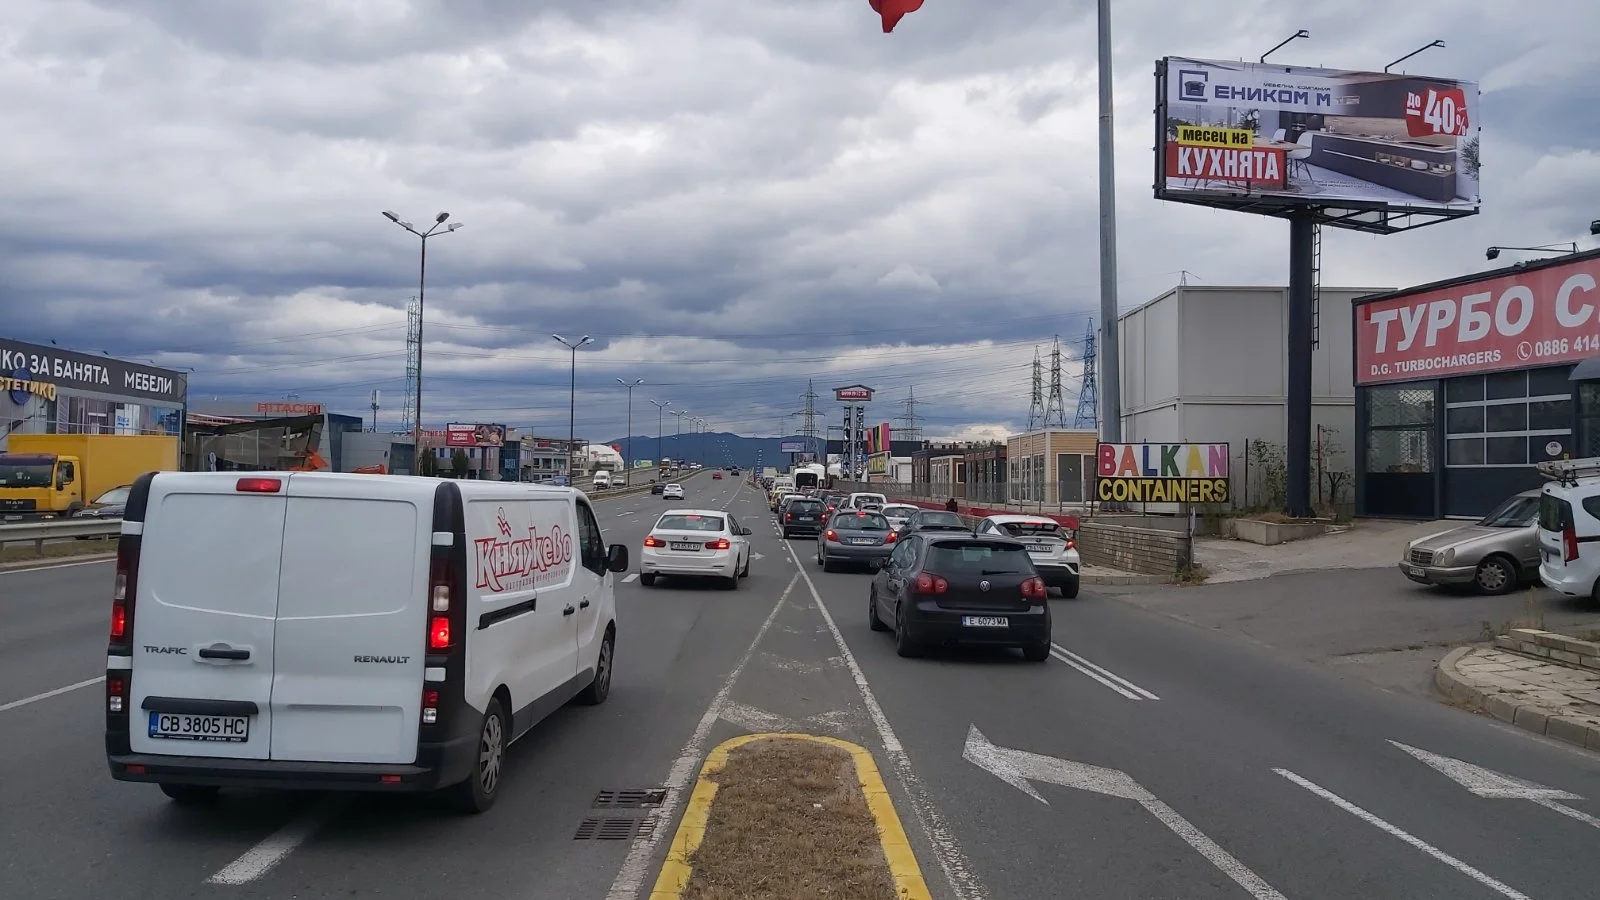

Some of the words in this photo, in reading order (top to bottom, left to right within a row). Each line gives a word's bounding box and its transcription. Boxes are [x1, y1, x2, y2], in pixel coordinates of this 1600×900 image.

[1214, 85, 1309, 105] ЕНИКОМ
[1316, 92, 1331, 106] М
[1183, 129, 1227, 144] месец
[1232, 132, 1248, 144] на
[1178, 147, 1280, 180] КУХНЯТА
[1370, 285, 1535, 354] ТУРБО
[1555, 273, 1600, 328] С
[1535, 338, 1569, 357] 0886
[1573, 334, 1600, 352] 414
[0, 349, 26, 370] КО
[30, 354, 50, 375] ЗА
[53, 358, 110, 386] БАНЯТА
[124, 371, 173, 395] МЕБЕЛИ
[1370, 364, 1392, 376] D.G.
[1395, 349, 1502, 373] TURBOCHARGERS
[1099, 445, 1227, 477] BALKAN
[1099, 479, 1227, 502] CONTAINERS
[144, 645, 188, 655] TRAFIC
[354, 655, 410, 664] RENAULT
[160, 715, 180, 732] CB
[183, 716, 220, 734] 3805
[223, 718, 245, 735] HC
